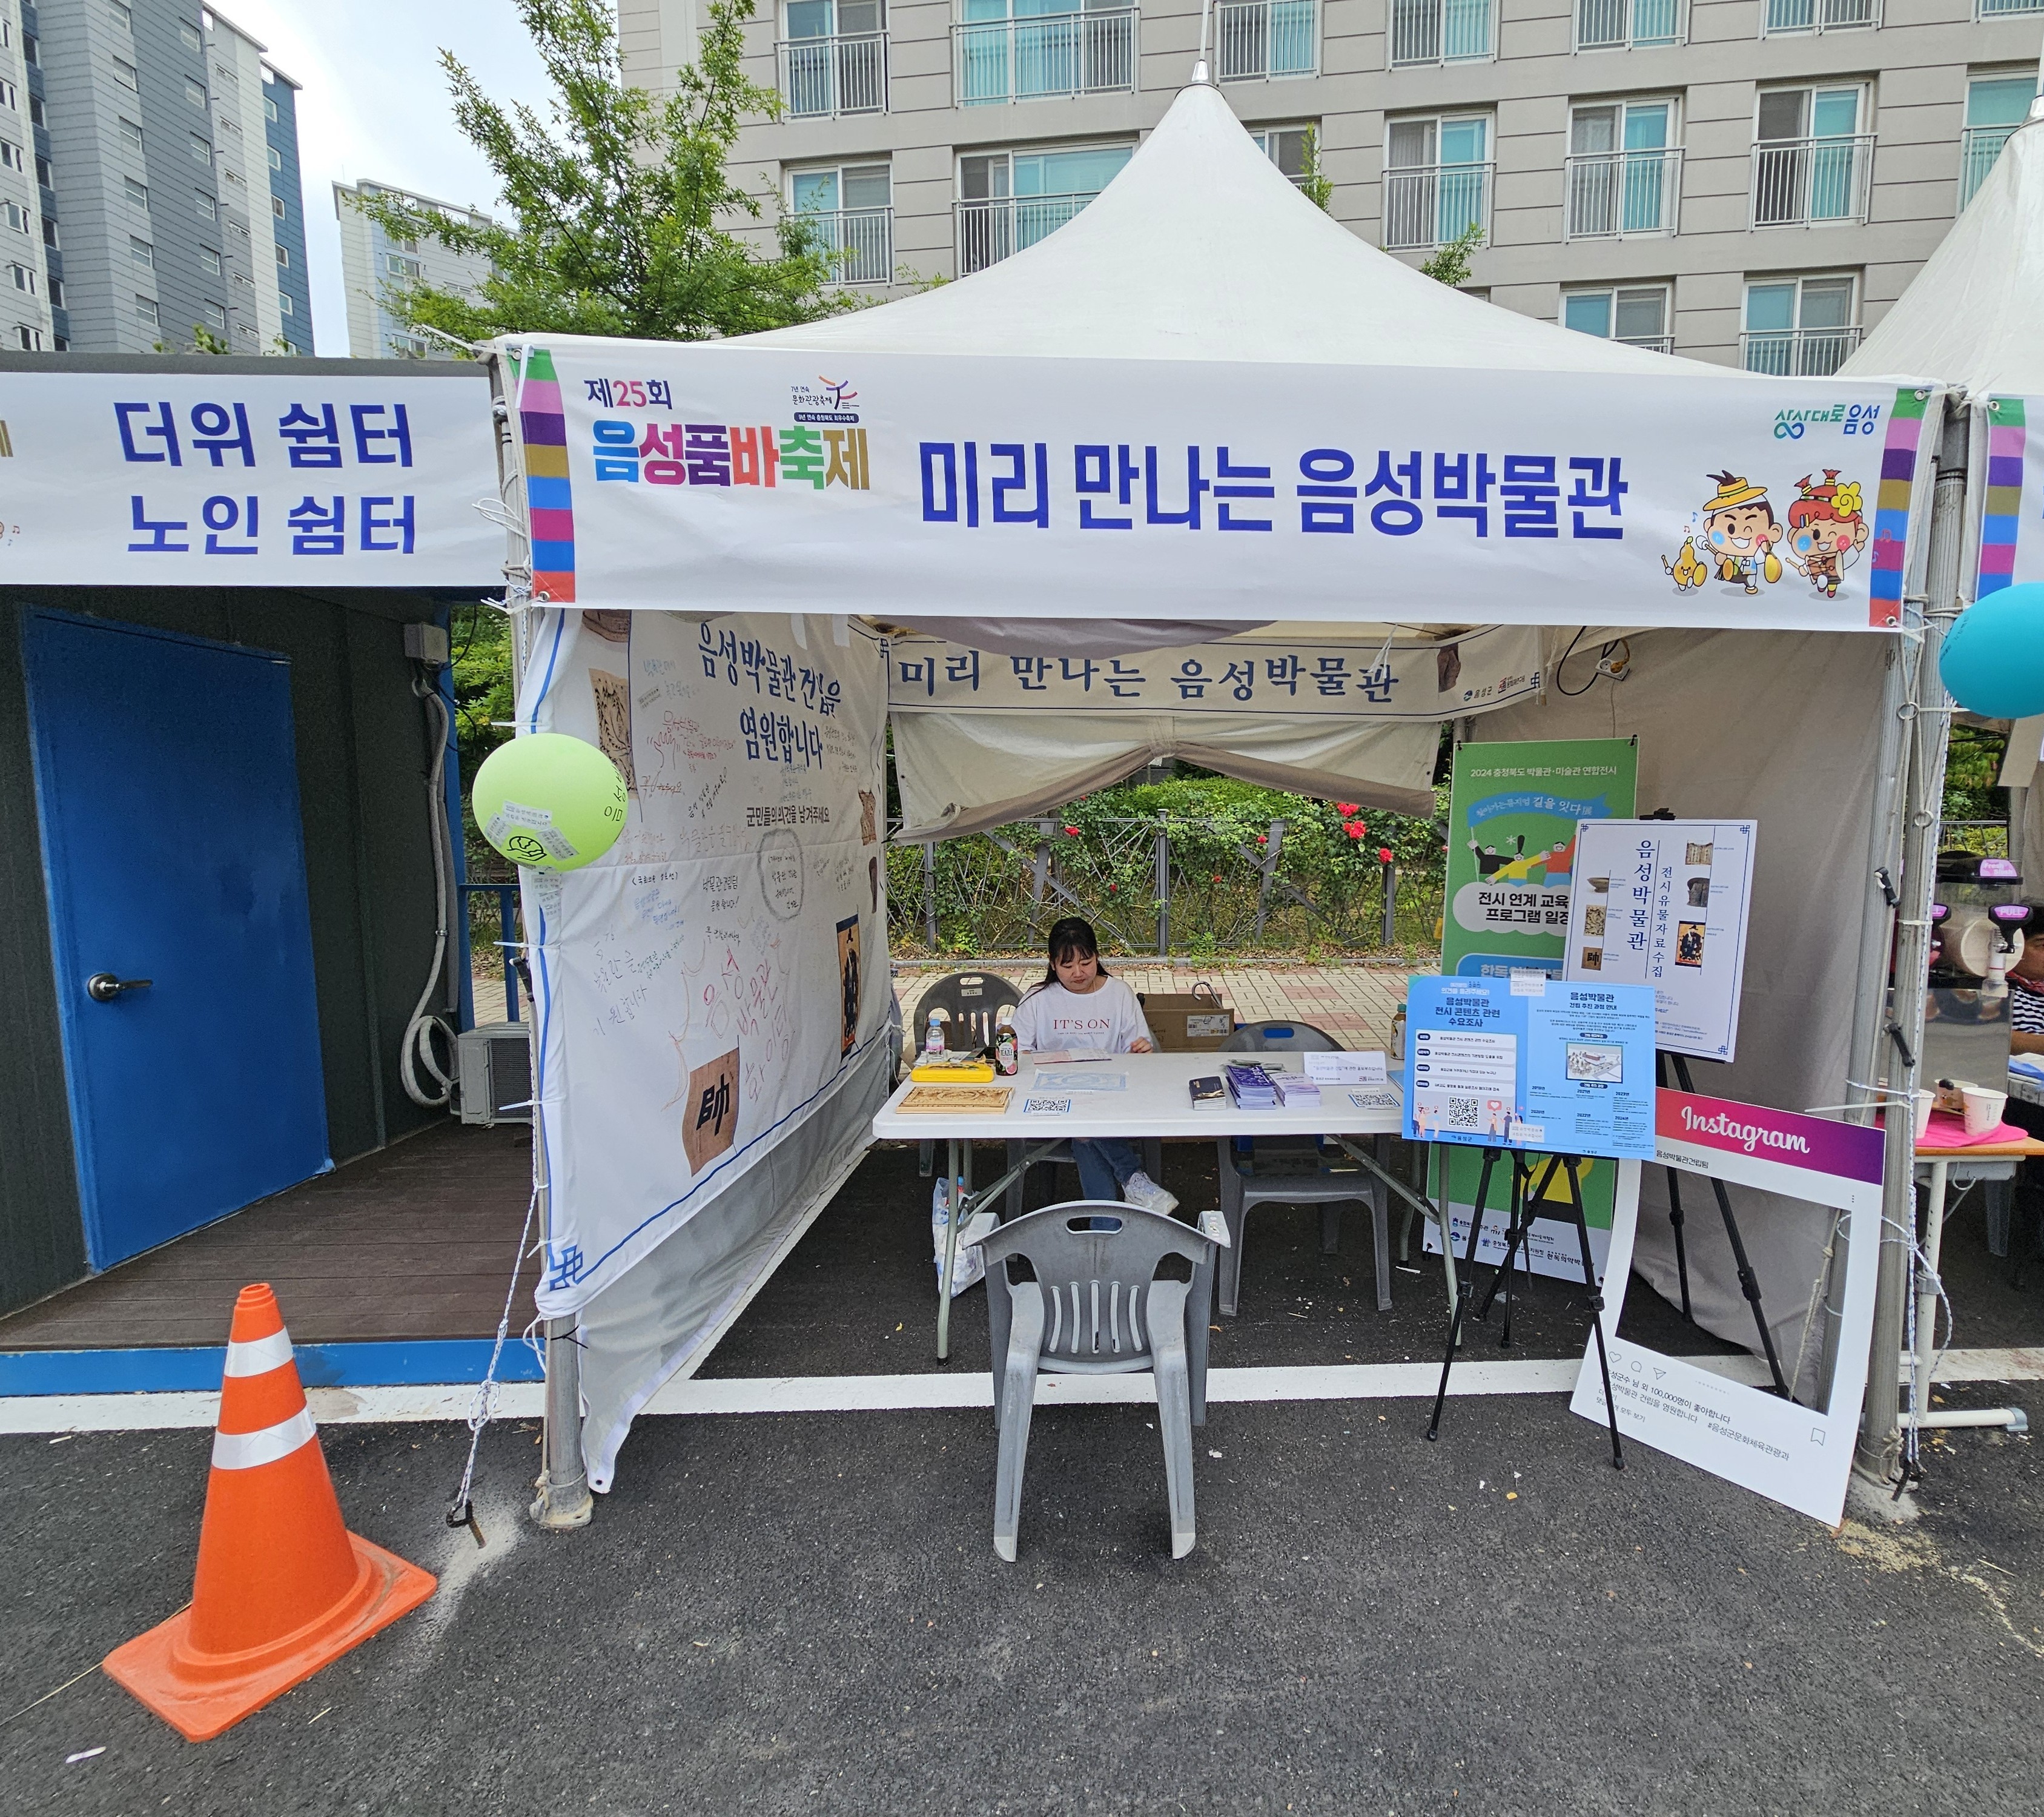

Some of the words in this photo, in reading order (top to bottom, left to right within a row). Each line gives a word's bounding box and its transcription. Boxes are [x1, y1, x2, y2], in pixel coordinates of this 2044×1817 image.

[584, 378, 673, 411] 제25회
[792, 395, 832, 406] 문화관광축제
[1844, 405, 1880, 436] 음성
[114, 402, 256, 468] 더위
[278, 403, 414, 468] 쉼터
[592, 419, 870, 490] 음성품바축제
[919, 442, 1050, 529] 미리
[1074, 444, 1275, 531] 만나는
[1295, 448, 1629, 540] 음성박물관
[128, 495, 259, 555] 노인
[288, 495, 415, 555] 쉼터
[698, 621, 796, 703] 음성박물관
[898, 650, 979, 697] 미리
[1010, 656, 1146, 697] 만나는
[1170, 654, 1399, 703] 음성박물관
[740, 706, 822, 770] 염원합니다
[1470, 769, 1492, 777] 2024
[1493, 768, 1525, 776] 충청북도
[1583, 766, 1617, 776] 연합전시
[746, 807, 778, 827] 군민들의
[778, 805, 796, 825] 의견을
[798, 804, 830, 824] 남겨주세요
[1533, 796, 1555, 810] 길을
[1478, 892, 1505, 905] 전시
[1509, 893, 1536, 907] 연계
[1541, 895, 1569, 908] 교육
[1627, 839, 1655, 951] 음성박물관
[1486, 908, 1541, 924] 프로그램
[1446, 997, 1490, 1007] 음성박물관
[1570, 992, 1615, 1003] 음성박물관
[1054, 1019, 1083, 1030] IT'S
[1087, 1019, 1110, 1029] ON
[1435, 1007, 1452, 1016] 전시
[1455, 1007, 1480, 1017] 콘텐츠
[1482, 1008, 1500, 1018] 관련
[1449, 1018, 1483, 1027] 수요조사
[1681, 1106, 1810, 1154] Instagram
[1656, 1150, 1709, 1170] 음성박물관건립팀
[1632, 1379, 1639, 1388] 님
[1641, 1383, 1649, 1392] 외
[1650, 1386, 1692, 1409] 100,000명이
[1693, 1403, 1730, 1424] 좋아합니다
[1620, 1408, 1633, 1417] 모두
[1633, 1412, 1645, 1423] 보기
[1639, 1394, 1661, 1408] 건립을
[1662, 1403, 1698, 1423] 염원합니다
[1707, 1422, 1790, 1461] #음성군문화체육관광과
